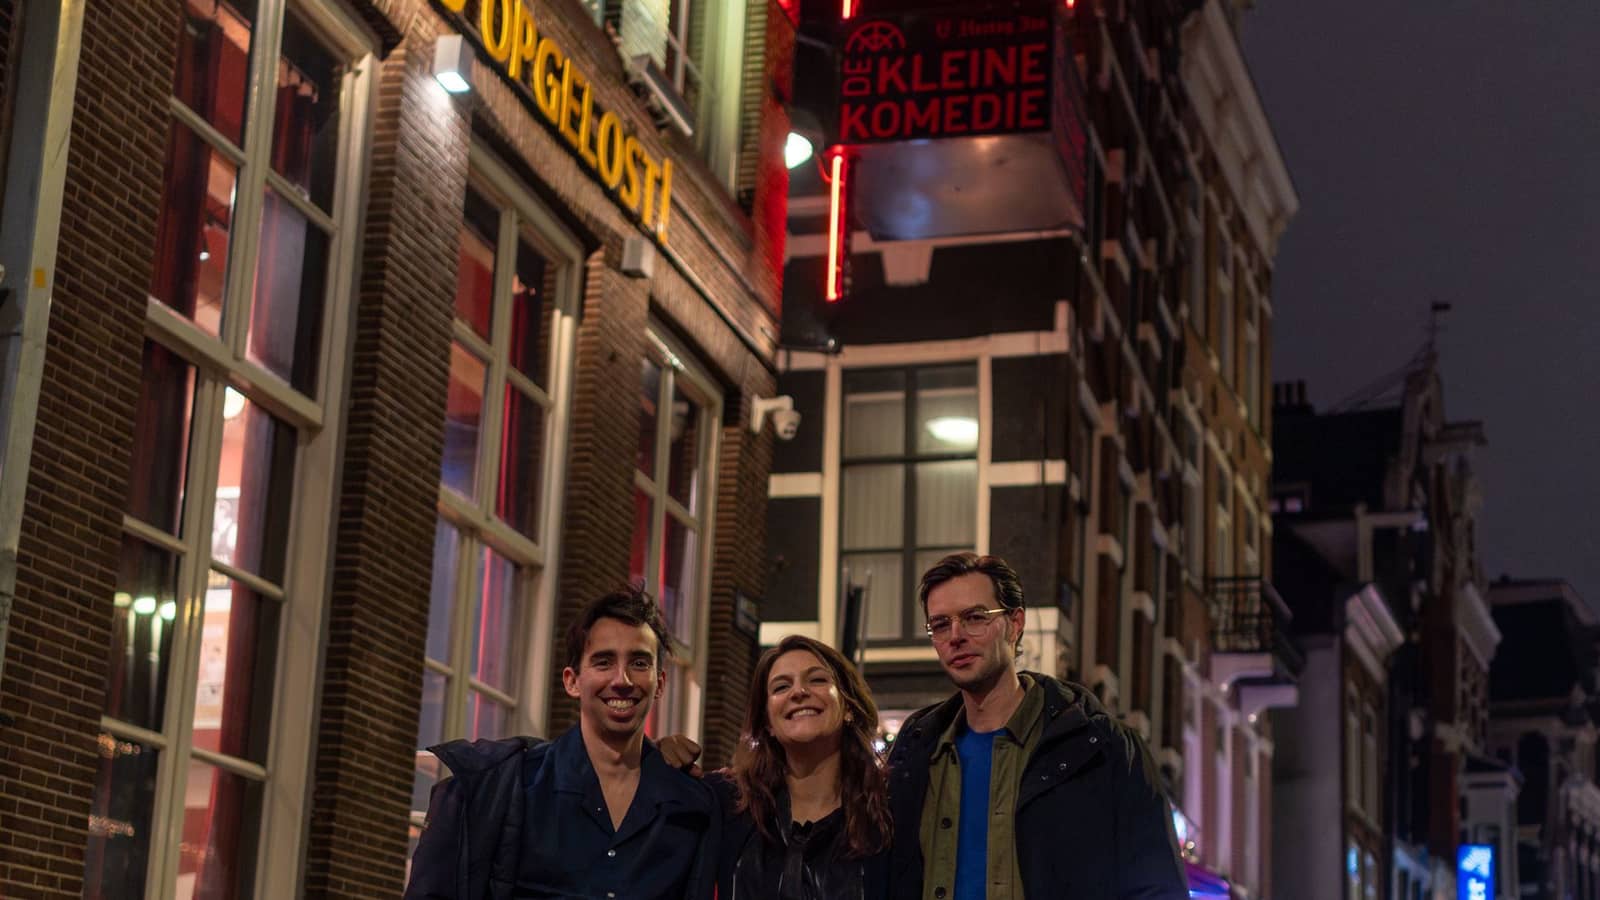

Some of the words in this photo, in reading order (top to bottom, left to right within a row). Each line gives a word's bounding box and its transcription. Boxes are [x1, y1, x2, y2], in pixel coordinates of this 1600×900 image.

[842, 57, 872, 97] DE
[876, 43, 1047, 96] KLEINE
[839, 90, 1045, 141] KOMEDIE
